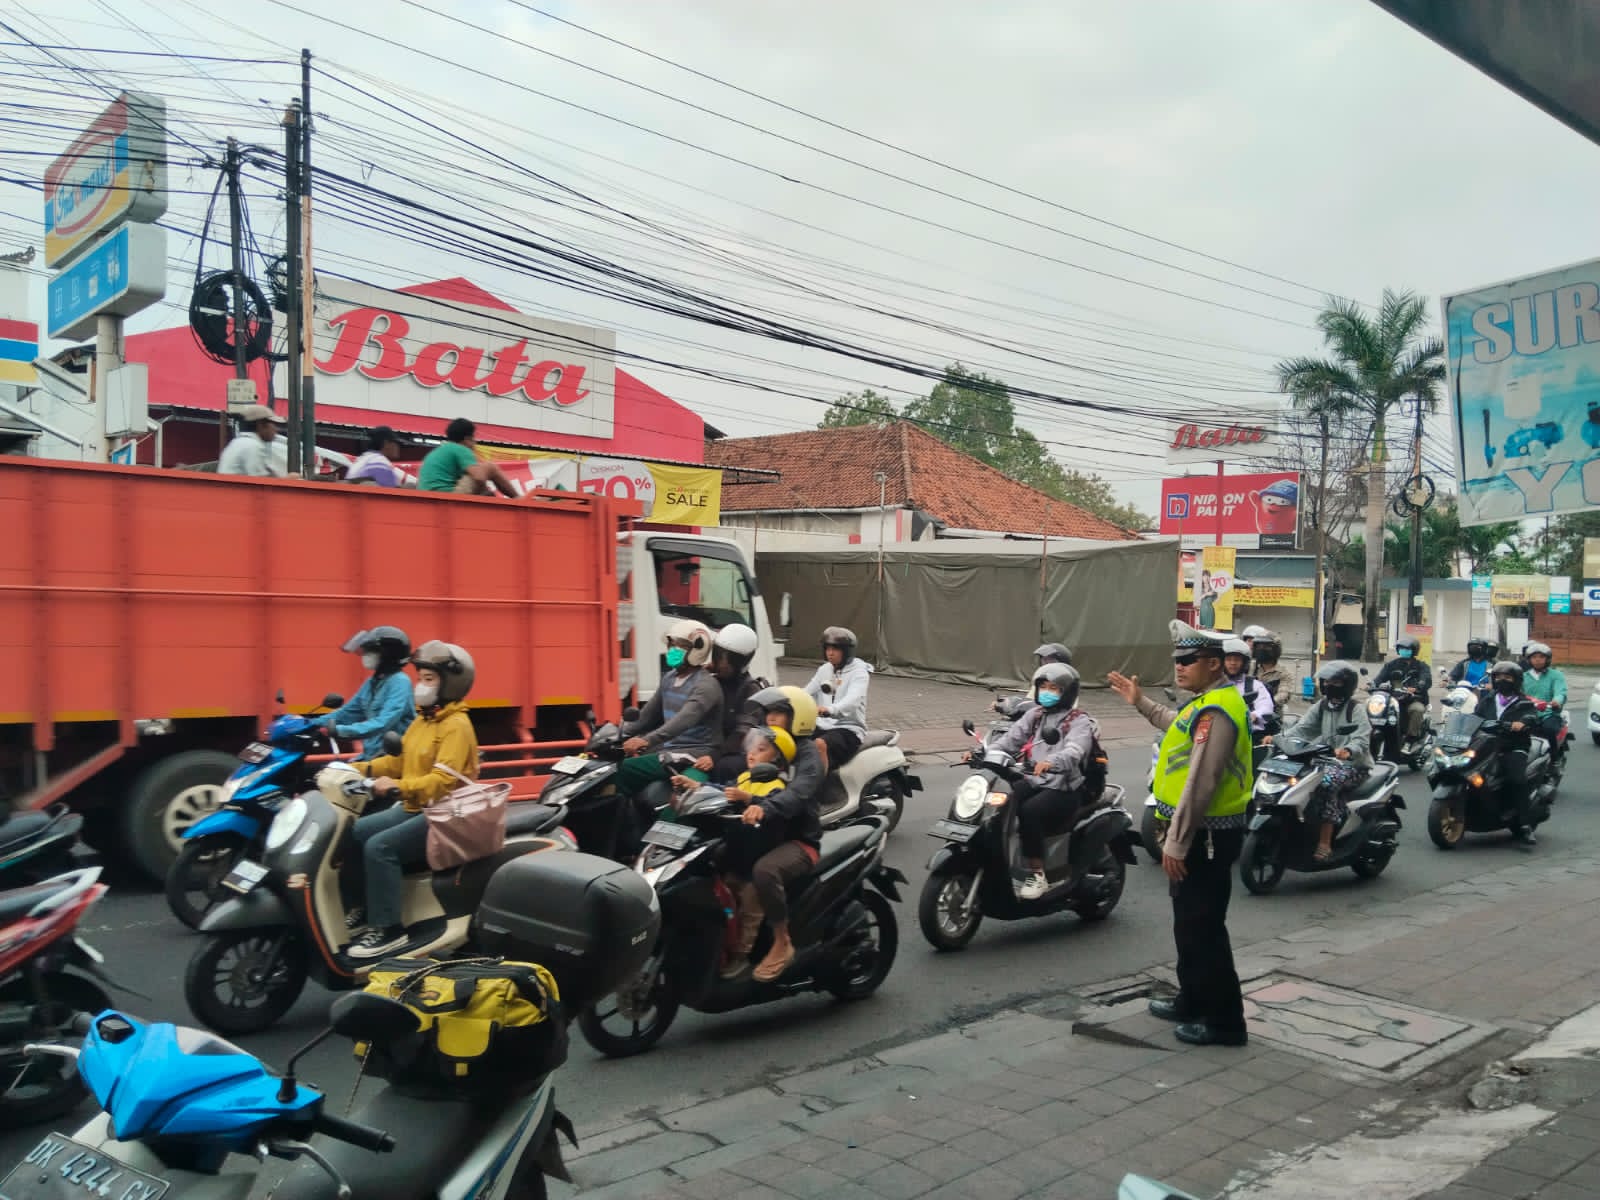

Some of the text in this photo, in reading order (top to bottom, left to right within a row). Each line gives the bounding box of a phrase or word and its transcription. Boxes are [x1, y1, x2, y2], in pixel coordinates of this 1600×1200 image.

[313, 307, 590, 406] Bata
[1169, 422, 1265, 449] Bata
[666, 492, 708, 507] SALE
[1193, 493, 1245, 505] NIPON
[25, 1139, 65, 1168] DK
